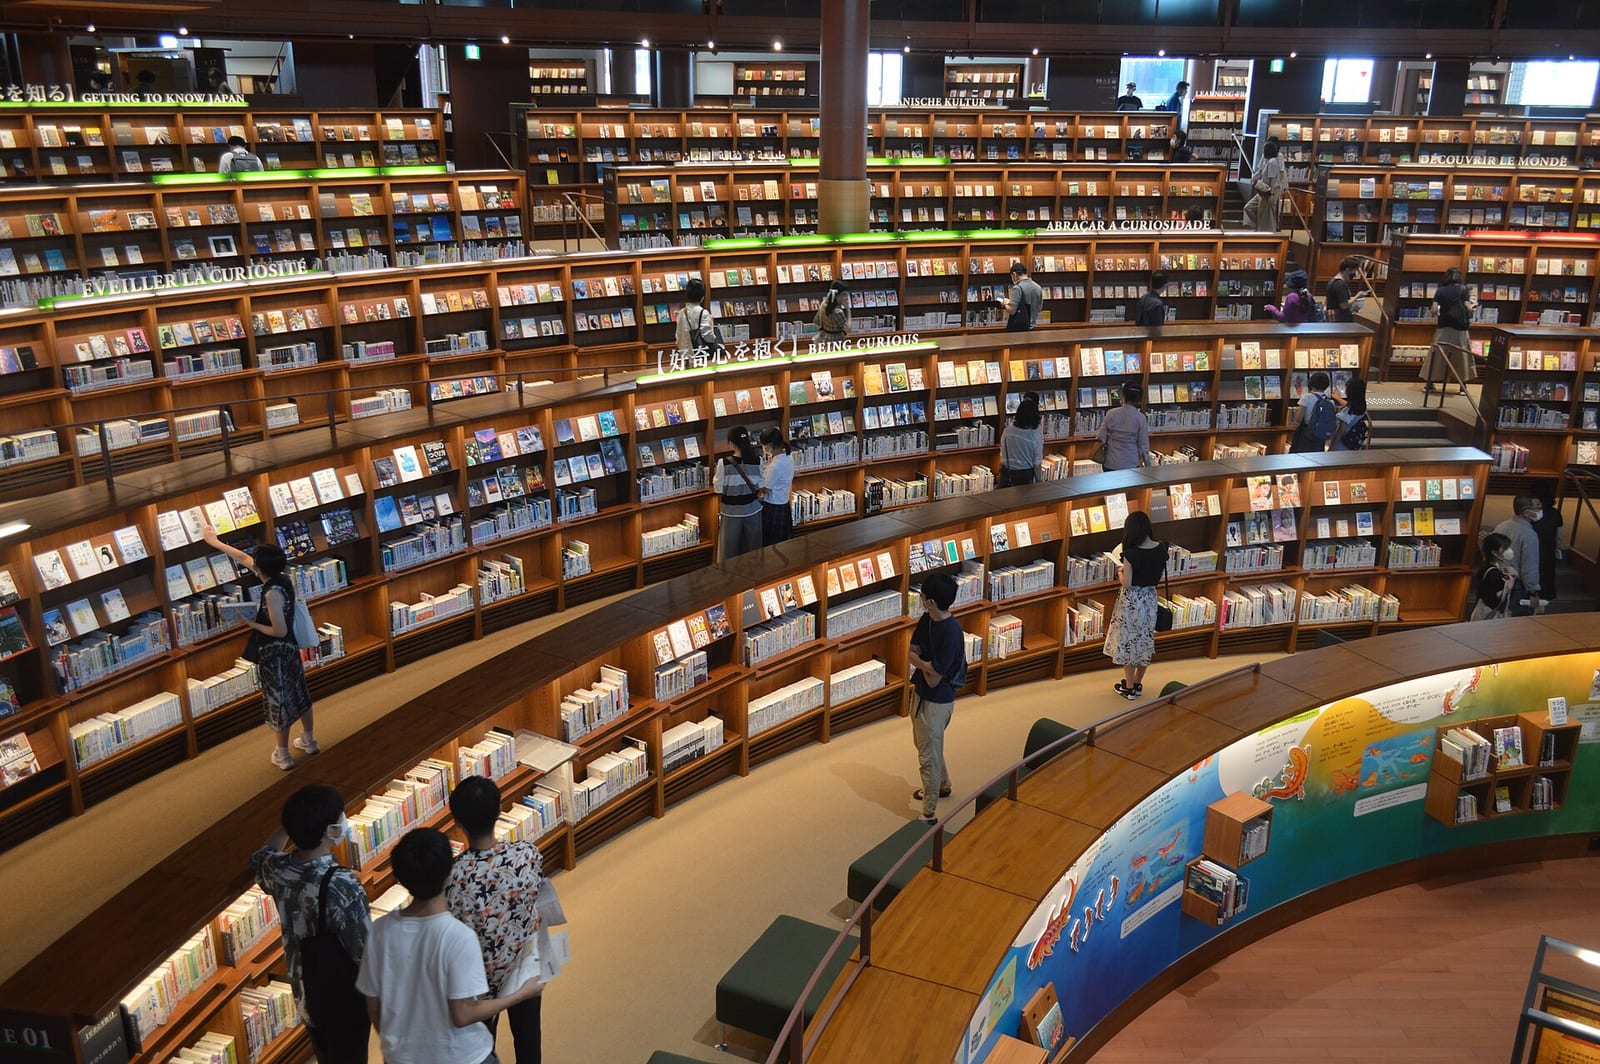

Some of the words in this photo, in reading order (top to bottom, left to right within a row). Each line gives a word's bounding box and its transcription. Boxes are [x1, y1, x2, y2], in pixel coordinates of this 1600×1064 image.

[82, 93, 140, 104] GETTING
[146, 93, 164, 103] TO
[166, 93, 206, 103] KNOW
[206, 93, 245, 106] JAPAN
[944, 97, 986, 107] KULTUR
[1419, 152, 1496, 165] DÉCOUVRIR
[1500, 154, 1515, 166] LE
[1517, 155, 1568, 167] MONDE
[1046, 220, 1106, 232] ABRAÇAR
[1108, 220, 1117, 231] A
[1120, 220, 1211, 231] CURIOSIDADE
[82, 273, 178, 298] ÉVEILLER
[183, 270, 205, 287] LA
[209, 257, 308, 283] CURIOSITÉ
[808, 339, 852, 355] BEING
[856, 333, 919, 350] CURIOUS
[657, 334, 798, 375] 【好奇心を抱く】
[22, 1027, 53, 1049] 01
